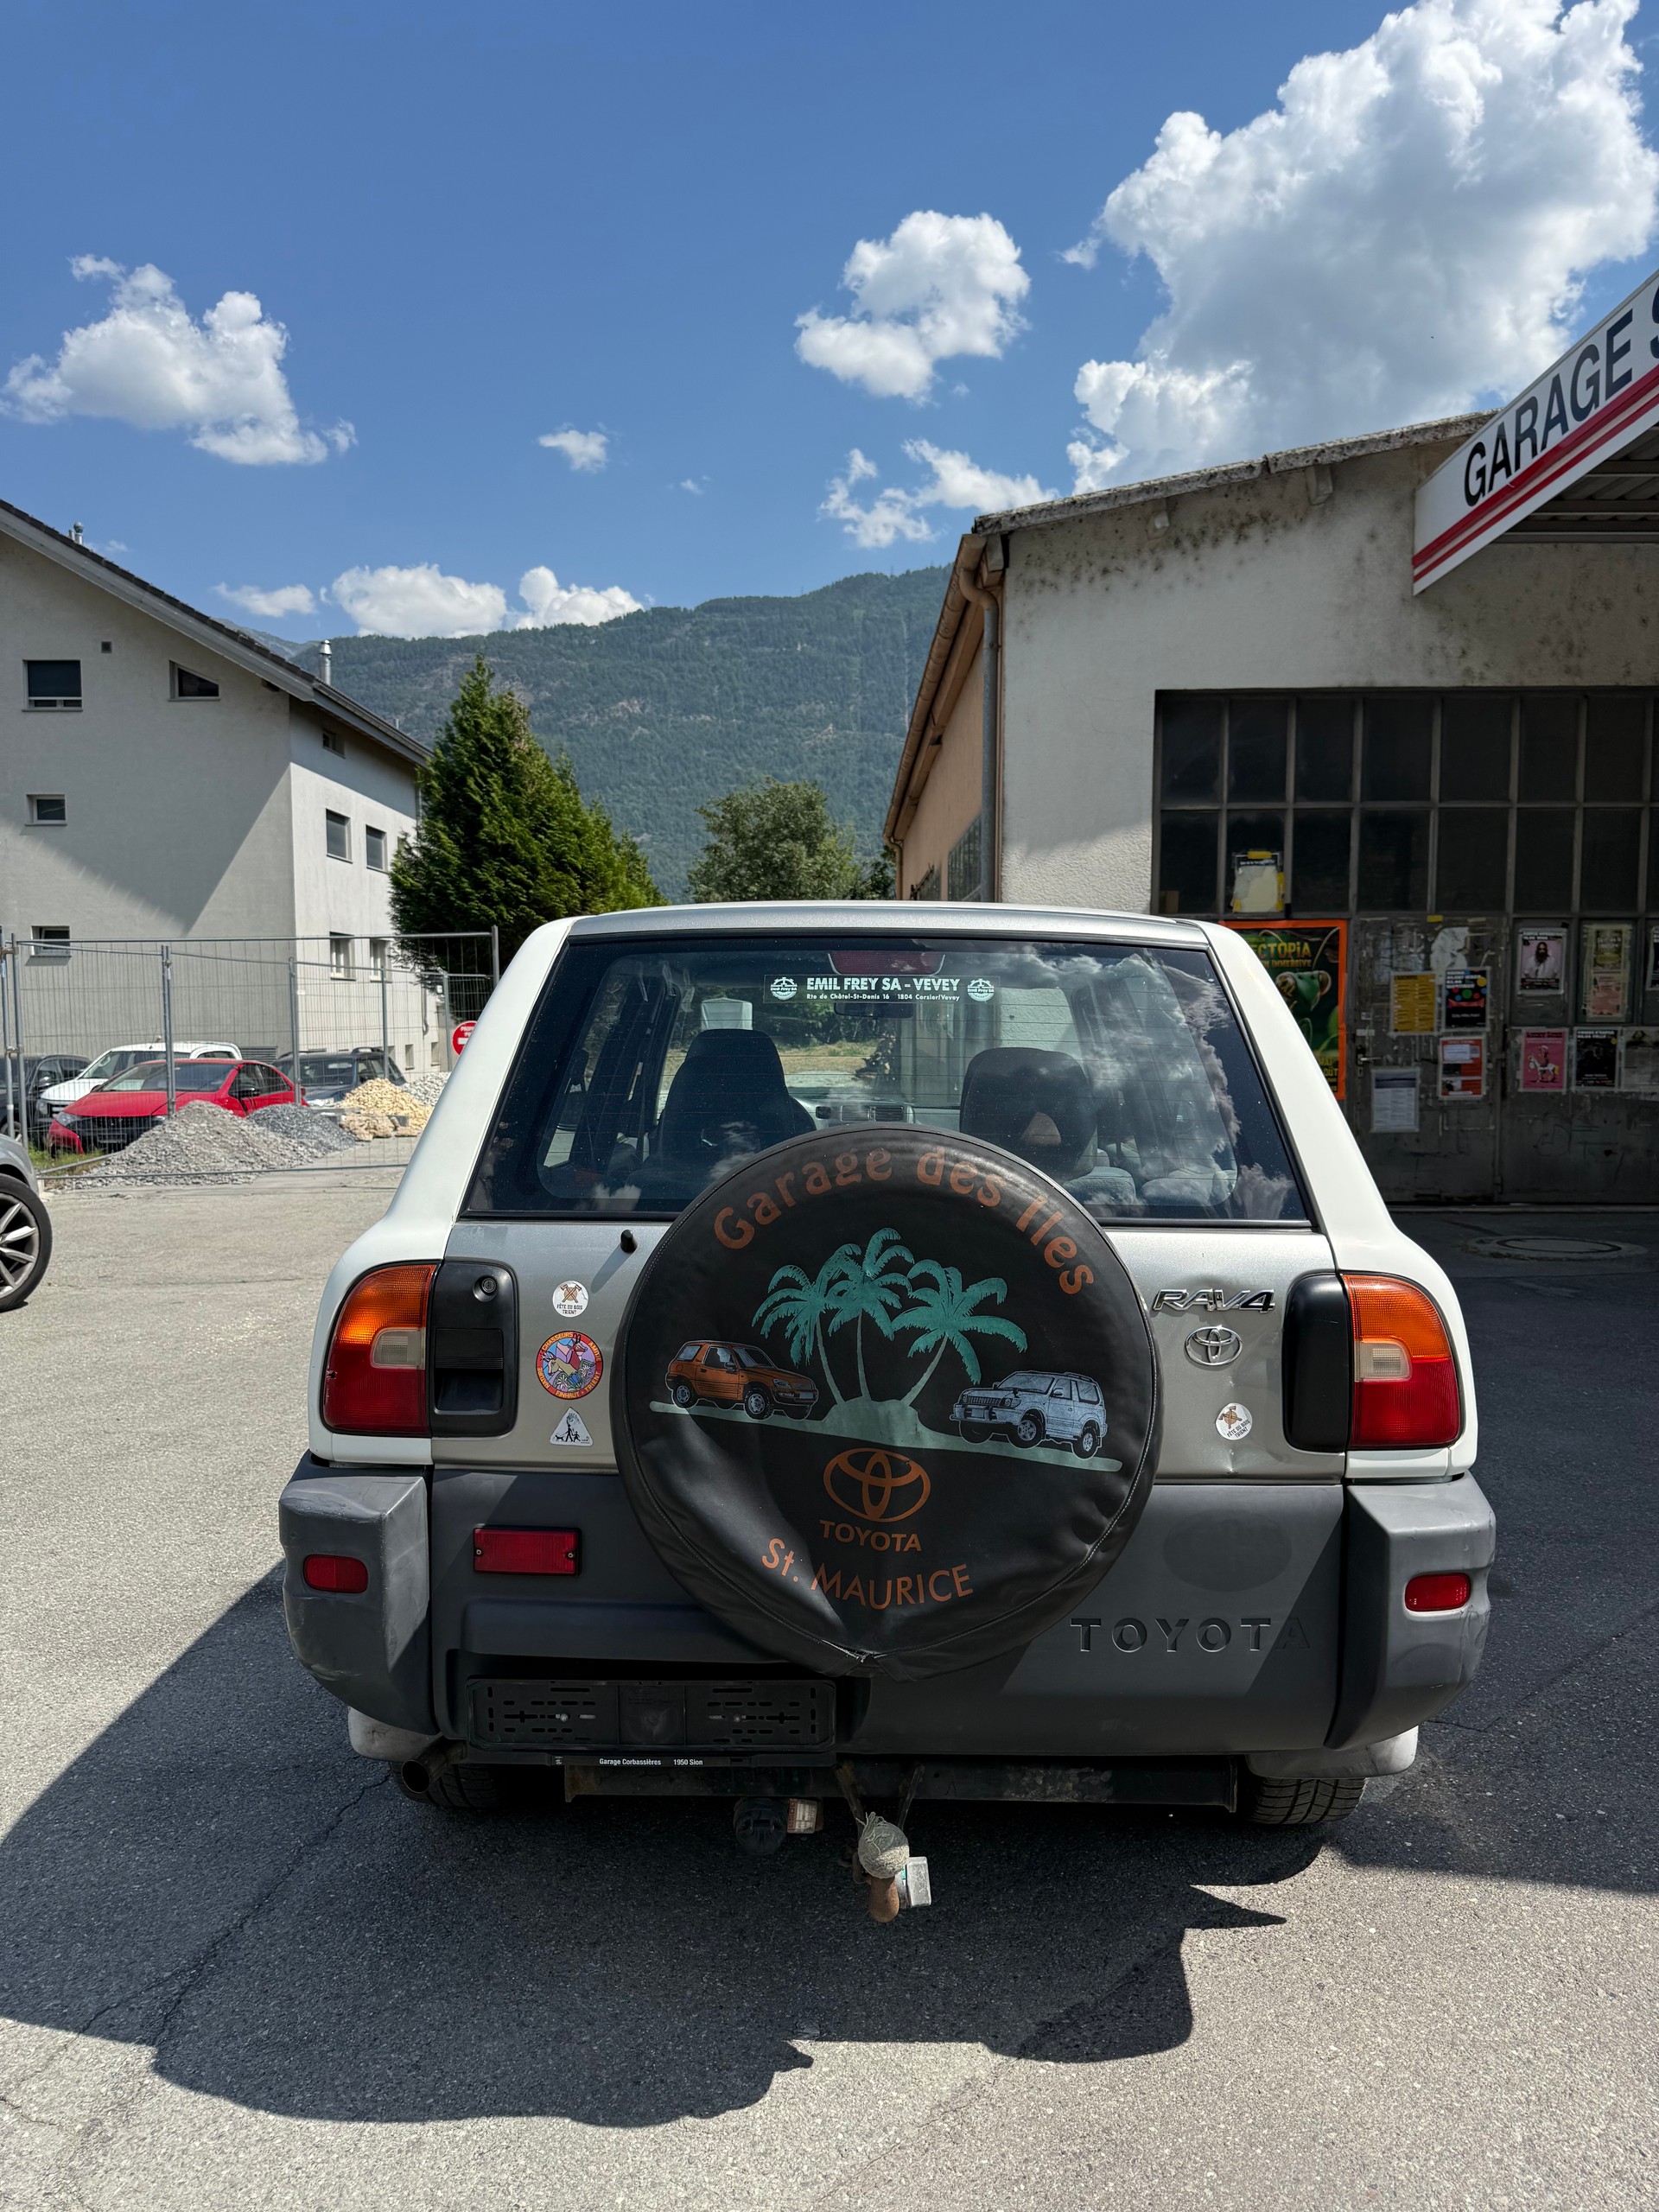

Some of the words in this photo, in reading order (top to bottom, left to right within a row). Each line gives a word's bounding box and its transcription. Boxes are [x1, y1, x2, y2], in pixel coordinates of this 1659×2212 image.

[1464, 308, 1634, 507] GARAGE
[806, 977, 840, 991] EMIL
[844, 977, 879, 991] FREY
[881, 977, 902, 992] SA
[912, 978, 961, 992] VEVEY
[714, 1147, 893, 1251] Garage
[917, 1146, 1007, 1209] des
[1152, 1288, 1276, 1313] RAV4
[542, 1332, 574, 1351] CHASSEURS
[584, 1371, 601, 1392] TRIENT
[819, 1518, 924, 1553] TOYOTA
[761, 1537, 799, 1583] St.
[810, 1562, 975, 1611] MAURICE
[1070, 1617, 1312, 1654] TOYOTA
[599, 1758, 621, 1766] Garage
[622, 1758, 662, 1766] Corbassières
